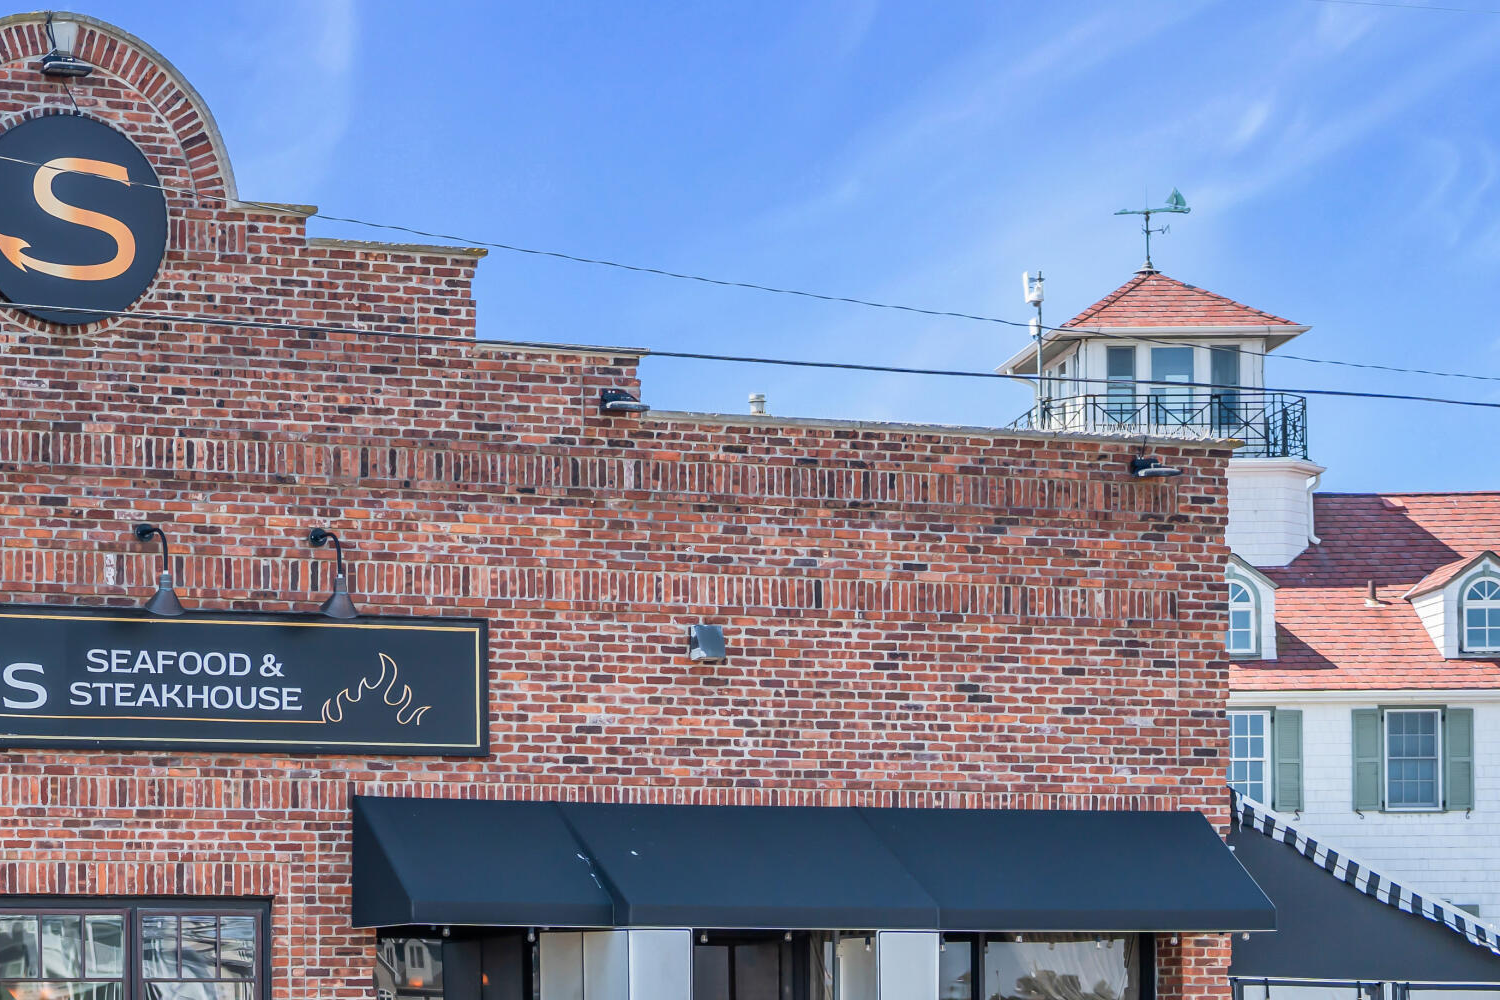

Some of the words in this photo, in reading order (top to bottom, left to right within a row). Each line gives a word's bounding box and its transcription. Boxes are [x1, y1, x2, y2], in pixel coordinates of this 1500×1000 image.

[86, 648, 252, 676] SEAFOOD
[259, 653, 285, 677] &
[69, 681, 303, 711] STEAKHOUSE
